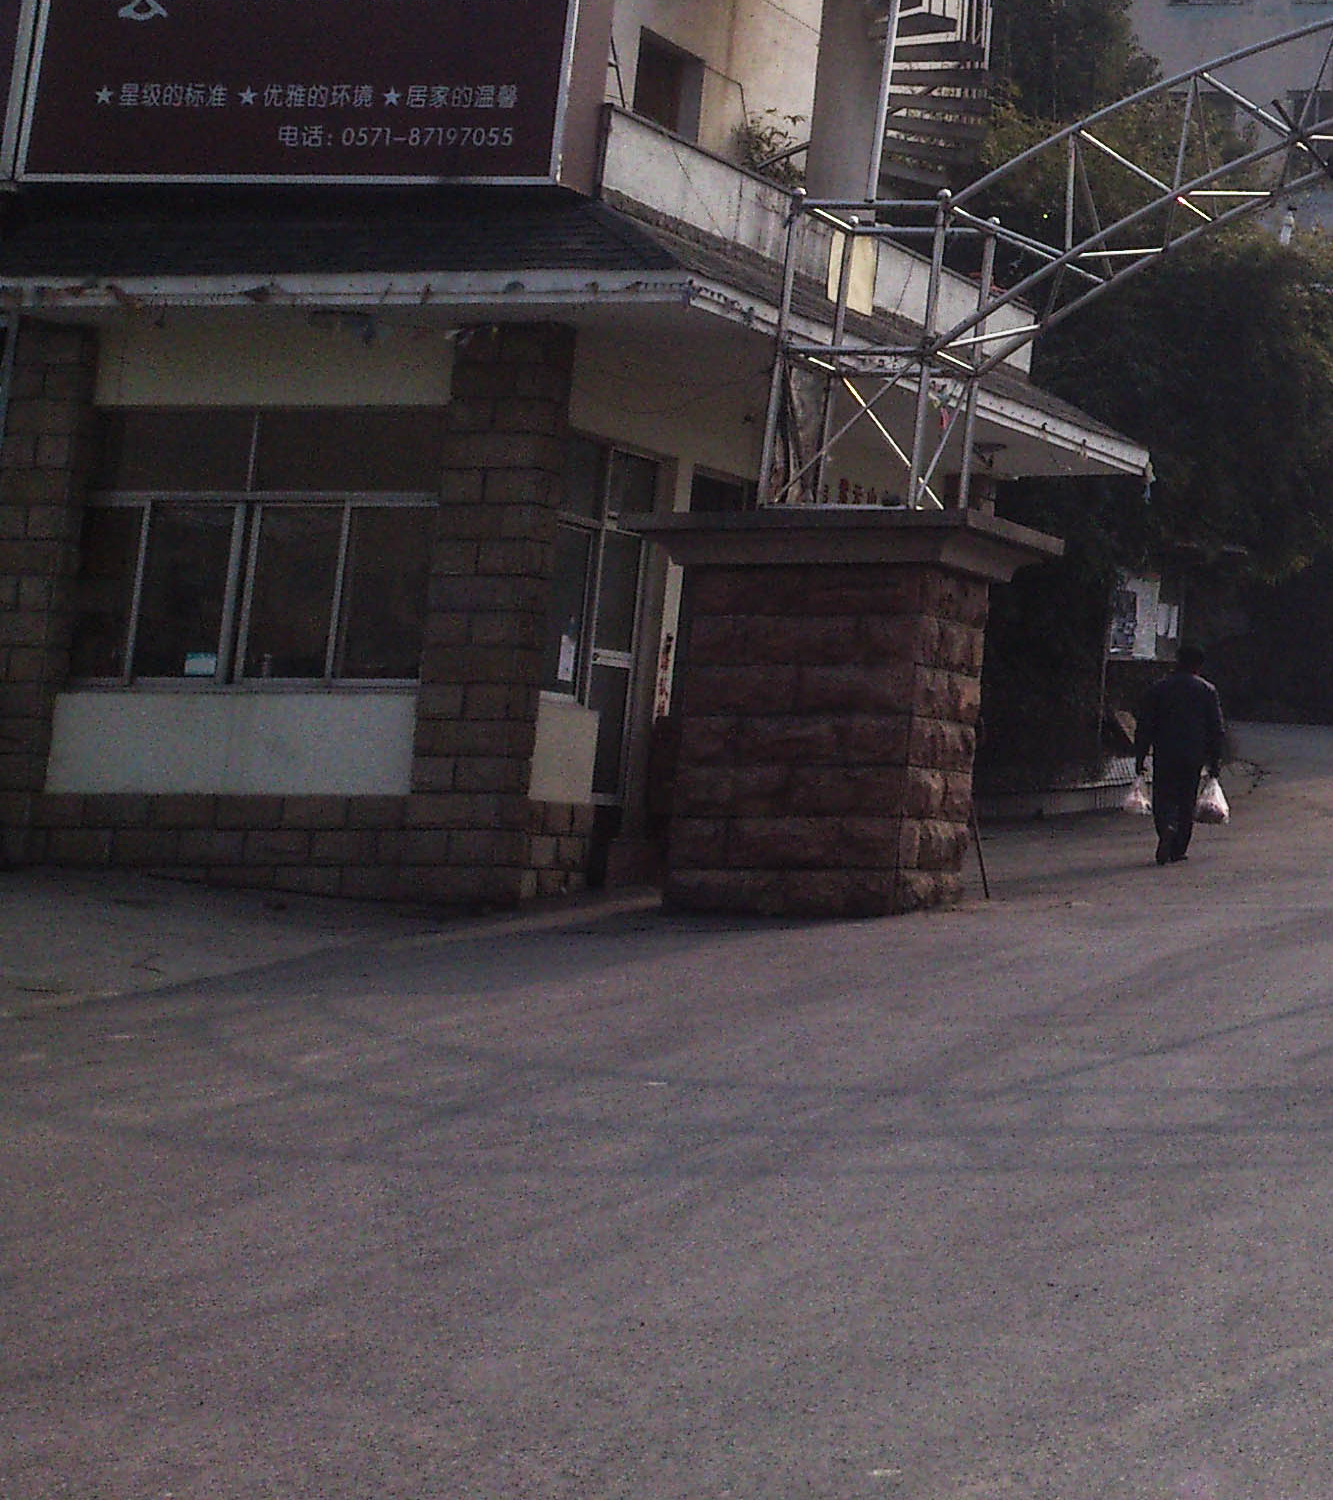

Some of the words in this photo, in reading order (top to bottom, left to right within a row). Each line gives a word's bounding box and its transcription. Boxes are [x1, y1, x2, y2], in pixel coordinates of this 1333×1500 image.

[119, 84, 228, 107] 星级的标准
[263, 85, 373, 108] 优雅的环境
[406, 84, 518, 108] 居家的温馨
